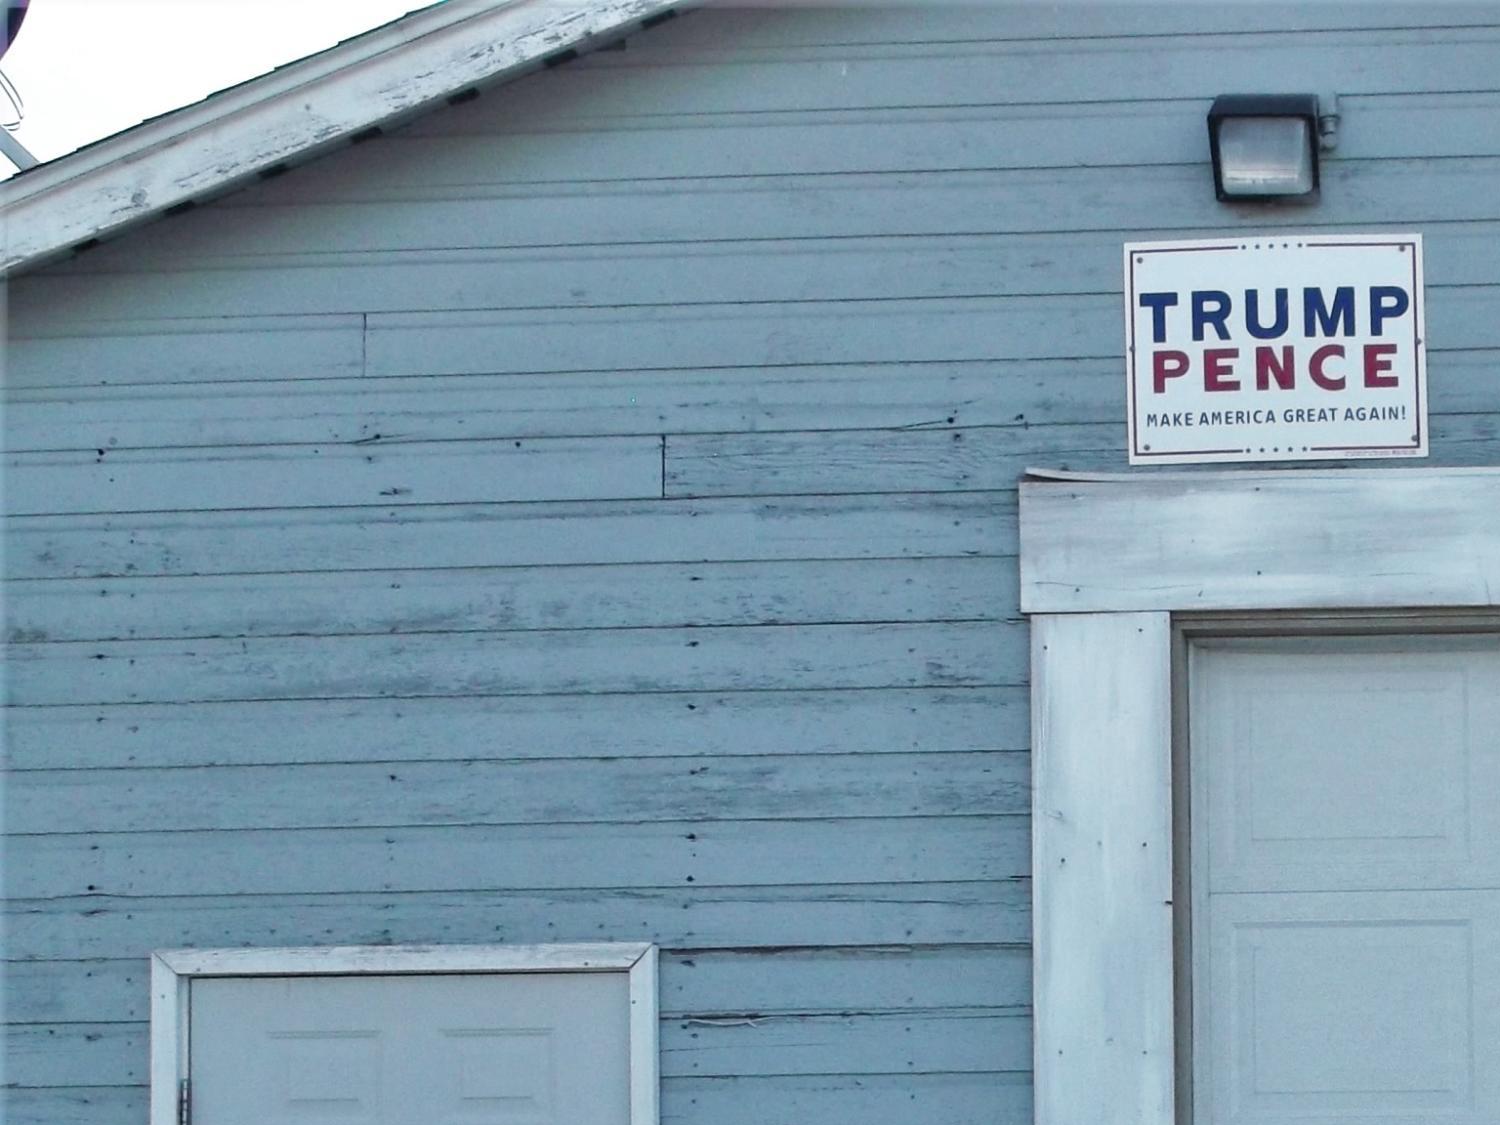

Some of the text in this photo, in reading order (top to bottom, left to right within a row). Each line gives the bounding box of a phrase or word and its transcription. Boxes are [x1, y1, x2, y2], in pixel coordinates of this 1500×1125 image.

[1139, 286, 1409, 343] TRUMP
[1153, 344, 1399, 394] PENCE
[1147, 405, 1406, 427] MAKE AMERICA GREAT AGAIN!
